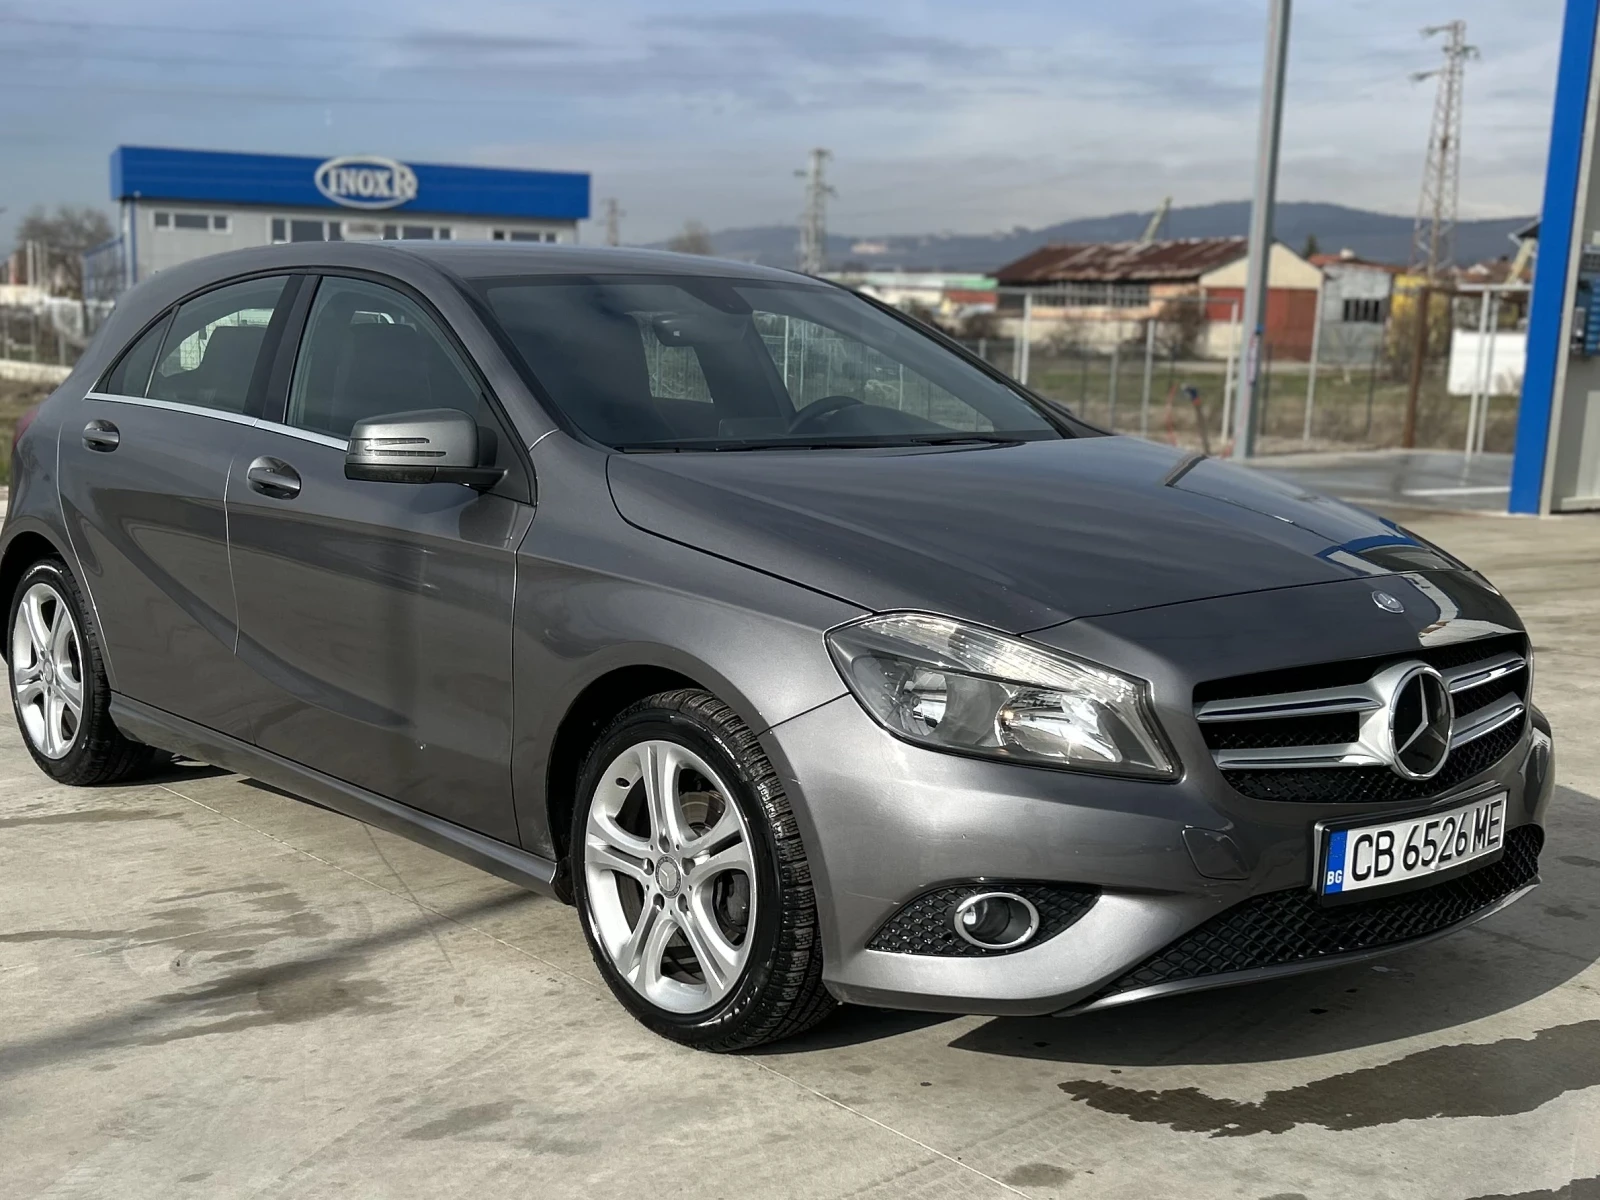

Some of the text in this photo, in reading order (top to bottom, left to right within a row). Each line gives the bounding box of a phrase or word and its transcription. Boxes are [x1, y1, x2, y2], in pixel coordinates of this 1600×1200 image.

[1351, 800, 1503, 882] CB 6526 ME
[1326, 869, 1343, 886] BG
